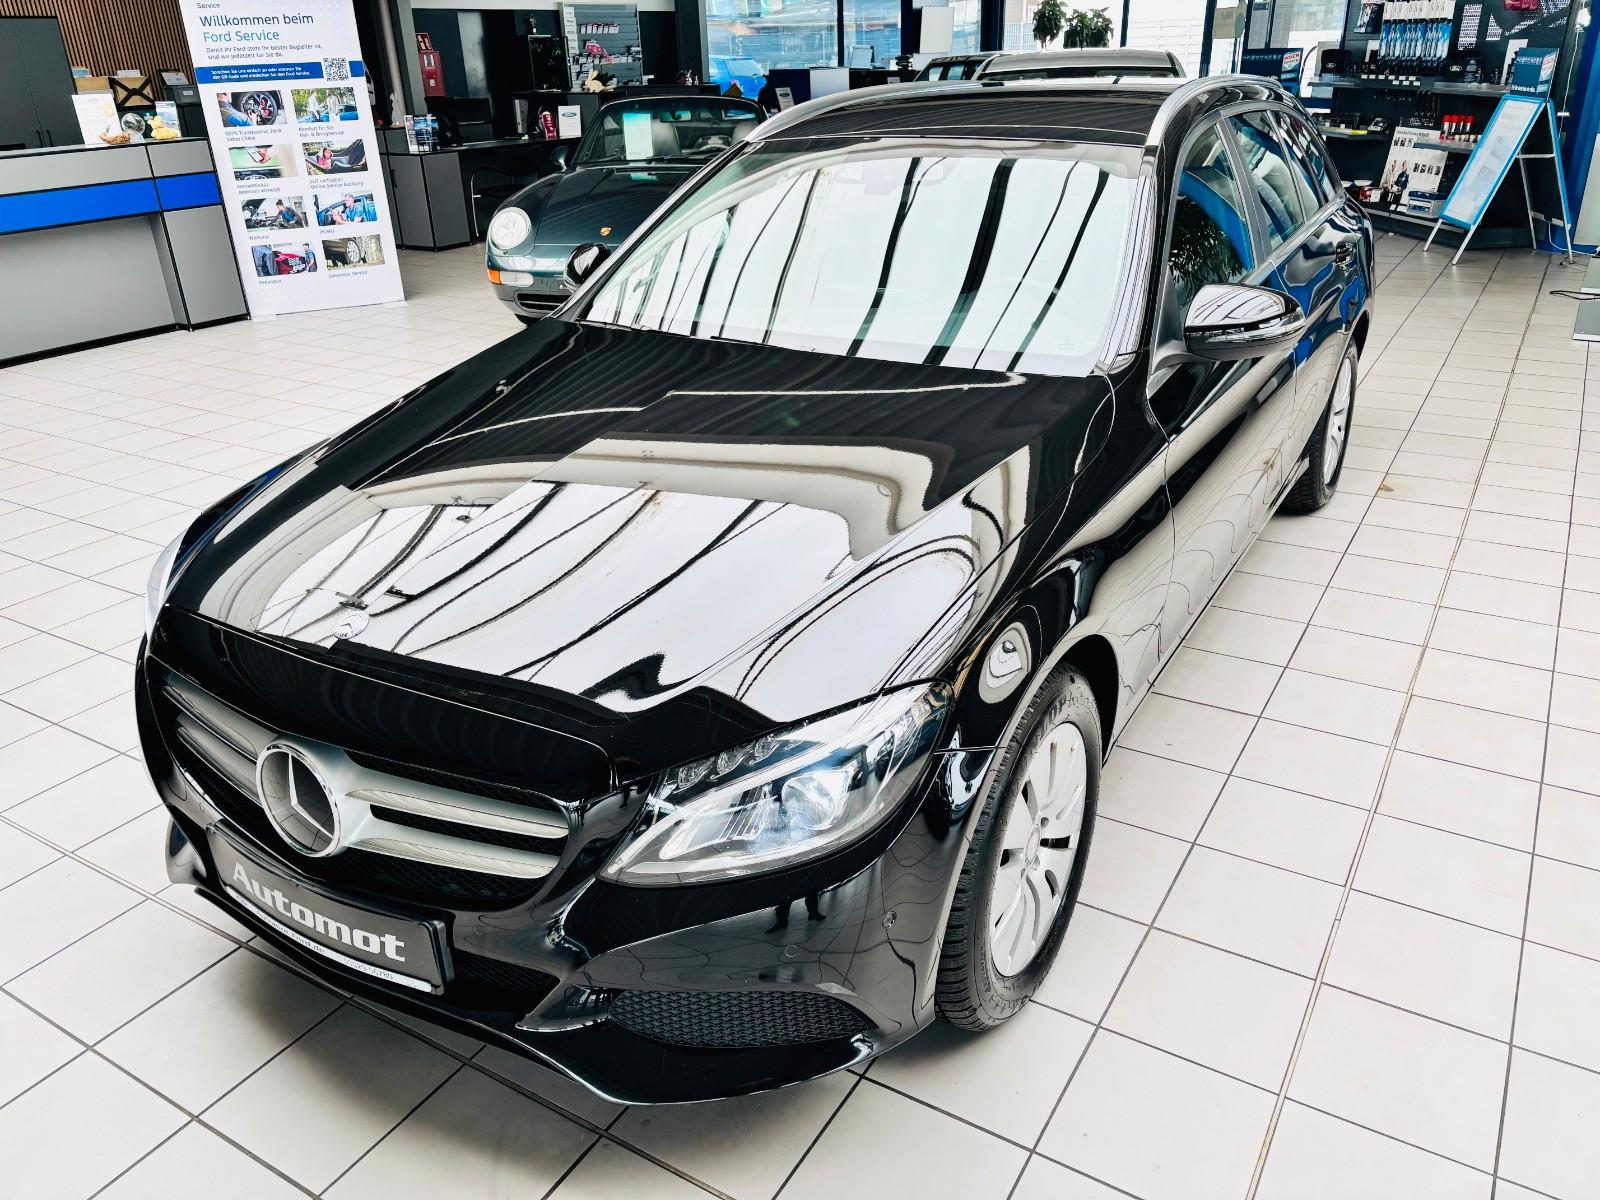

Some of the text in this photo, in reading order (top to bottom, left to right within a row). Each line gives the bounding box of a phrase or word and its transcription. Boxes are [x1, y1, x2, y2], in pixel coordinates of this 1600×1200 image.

[199, 12, 314, 27] Willkommen beim
[203, 29, 280, 43] Ford Service
[231, 860, 407, 963] Automot
